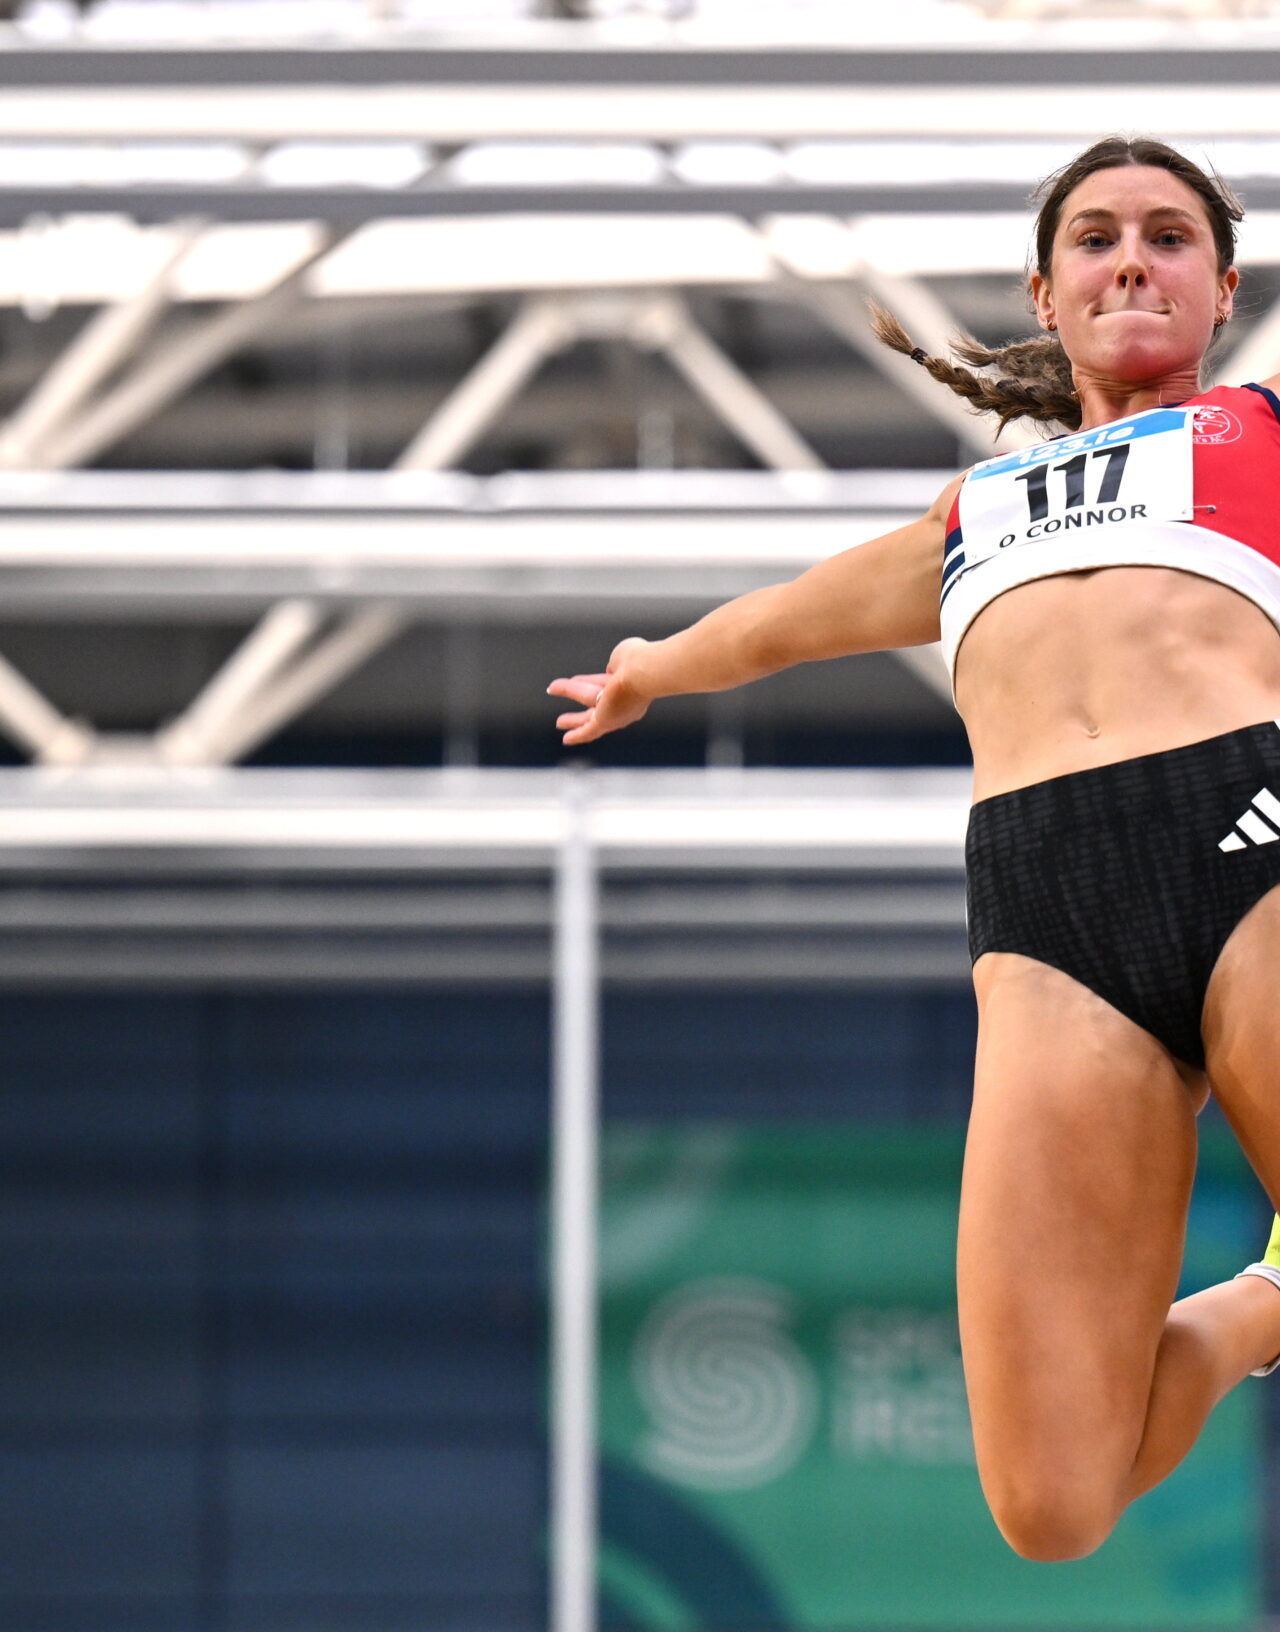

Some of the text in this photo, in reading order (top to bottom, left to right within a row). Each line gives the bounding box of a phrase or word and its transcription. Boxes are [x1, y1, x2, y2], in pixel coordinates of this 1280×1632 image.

[1018, 426, 1135, 464] 123.ie
[1014, 443, 1130, 523] 117
[999, 504, 1147, 548] O CONNOR
